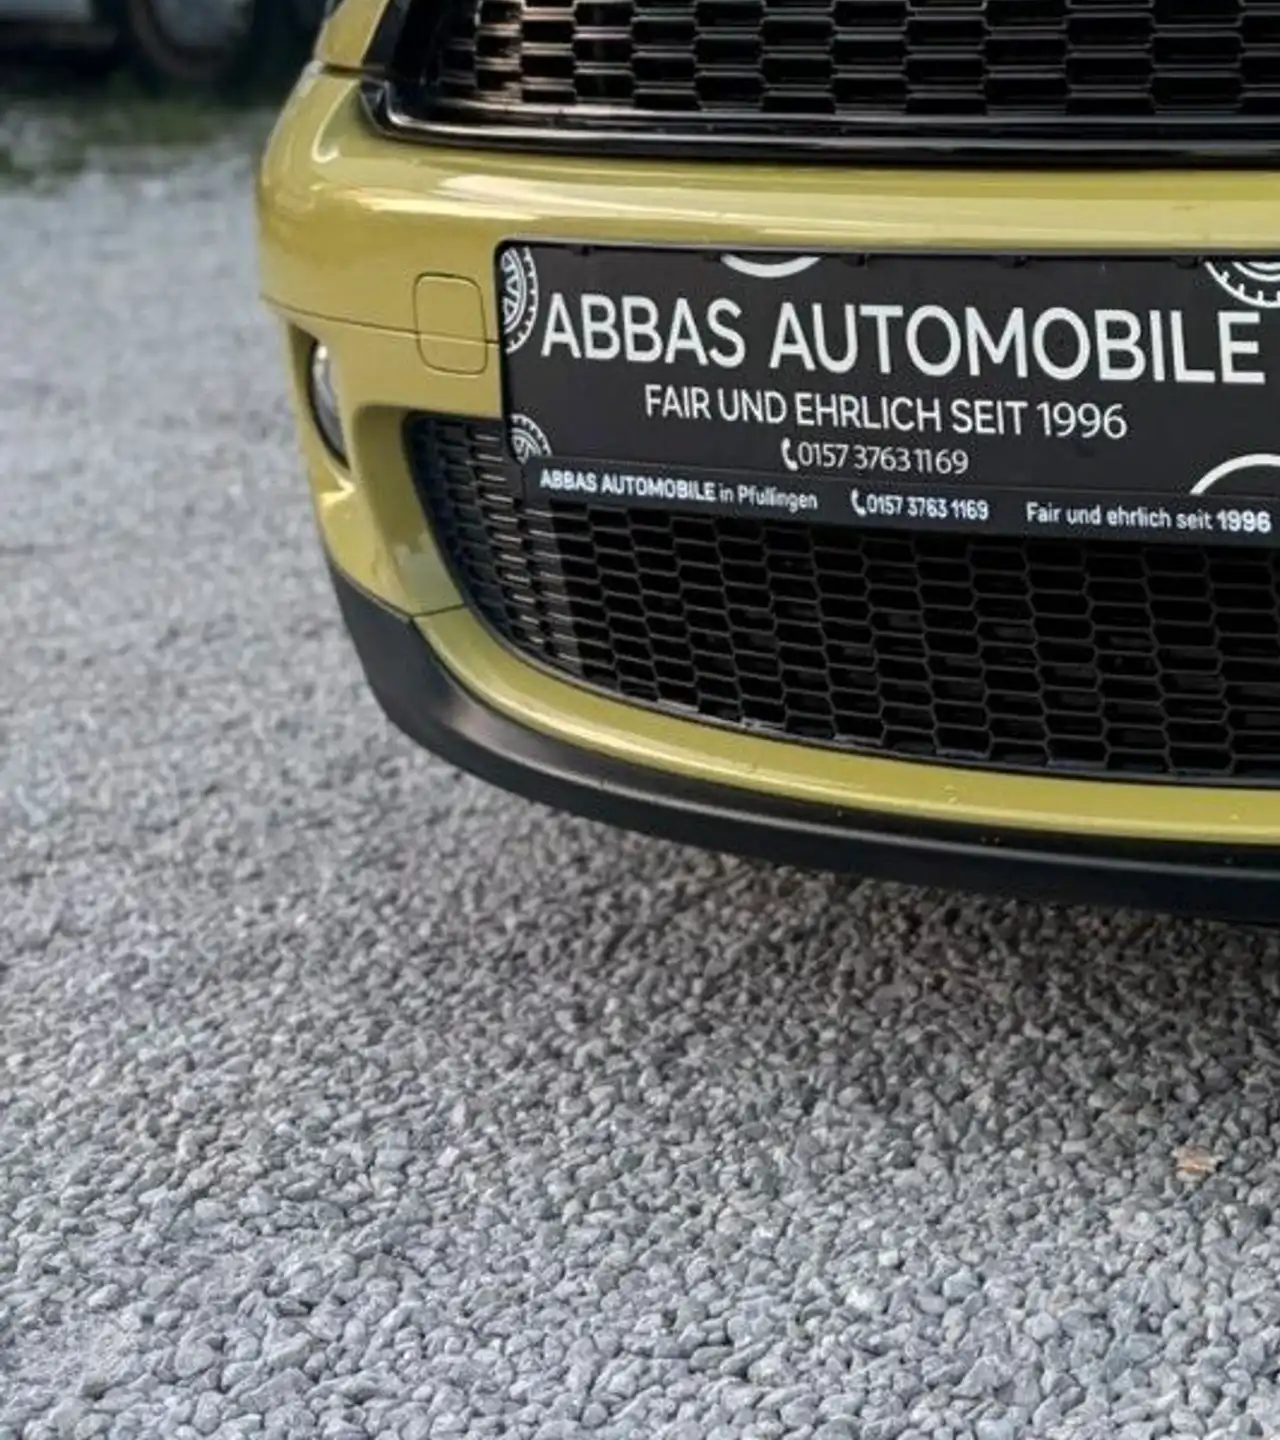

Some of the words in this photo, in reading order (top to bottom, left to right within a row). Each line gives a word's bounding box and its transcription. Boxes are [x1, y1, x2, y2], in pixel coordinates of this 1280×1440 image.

[540, 292, 746, 369] ABBAS
[768, 301, 1267, 385] AUTOMOBILE
[644, 383, 712, 420] FAIR
[717, 387, 788, 425] UND
[794, 391, 943, 433] EHRLICH
[950, 398, 1029, 436] SEIT
[1036, 401, 1128, 440] 1996
[797, 441, 850, 468] 0157
[539, 468, 598, 493] ABBAS
[601, 472, 717, 502] AUTOMOBILE
[719, 483, 735, 502] in
[737, 483, 819, 513] Pfullingen
[866, 493, 903, 515] 0157
[906, 496, 948, 519] 3763
[950, 498, 990, 521] 1169
[1025, 501, 1062, 523] Fair
[1065, 504, 1101, 526] und
[1106, 505, 1172, 528] ehrlich
[1175, 510, 1213, 530] seit
[1215, 509, 1273, 534] 1996
